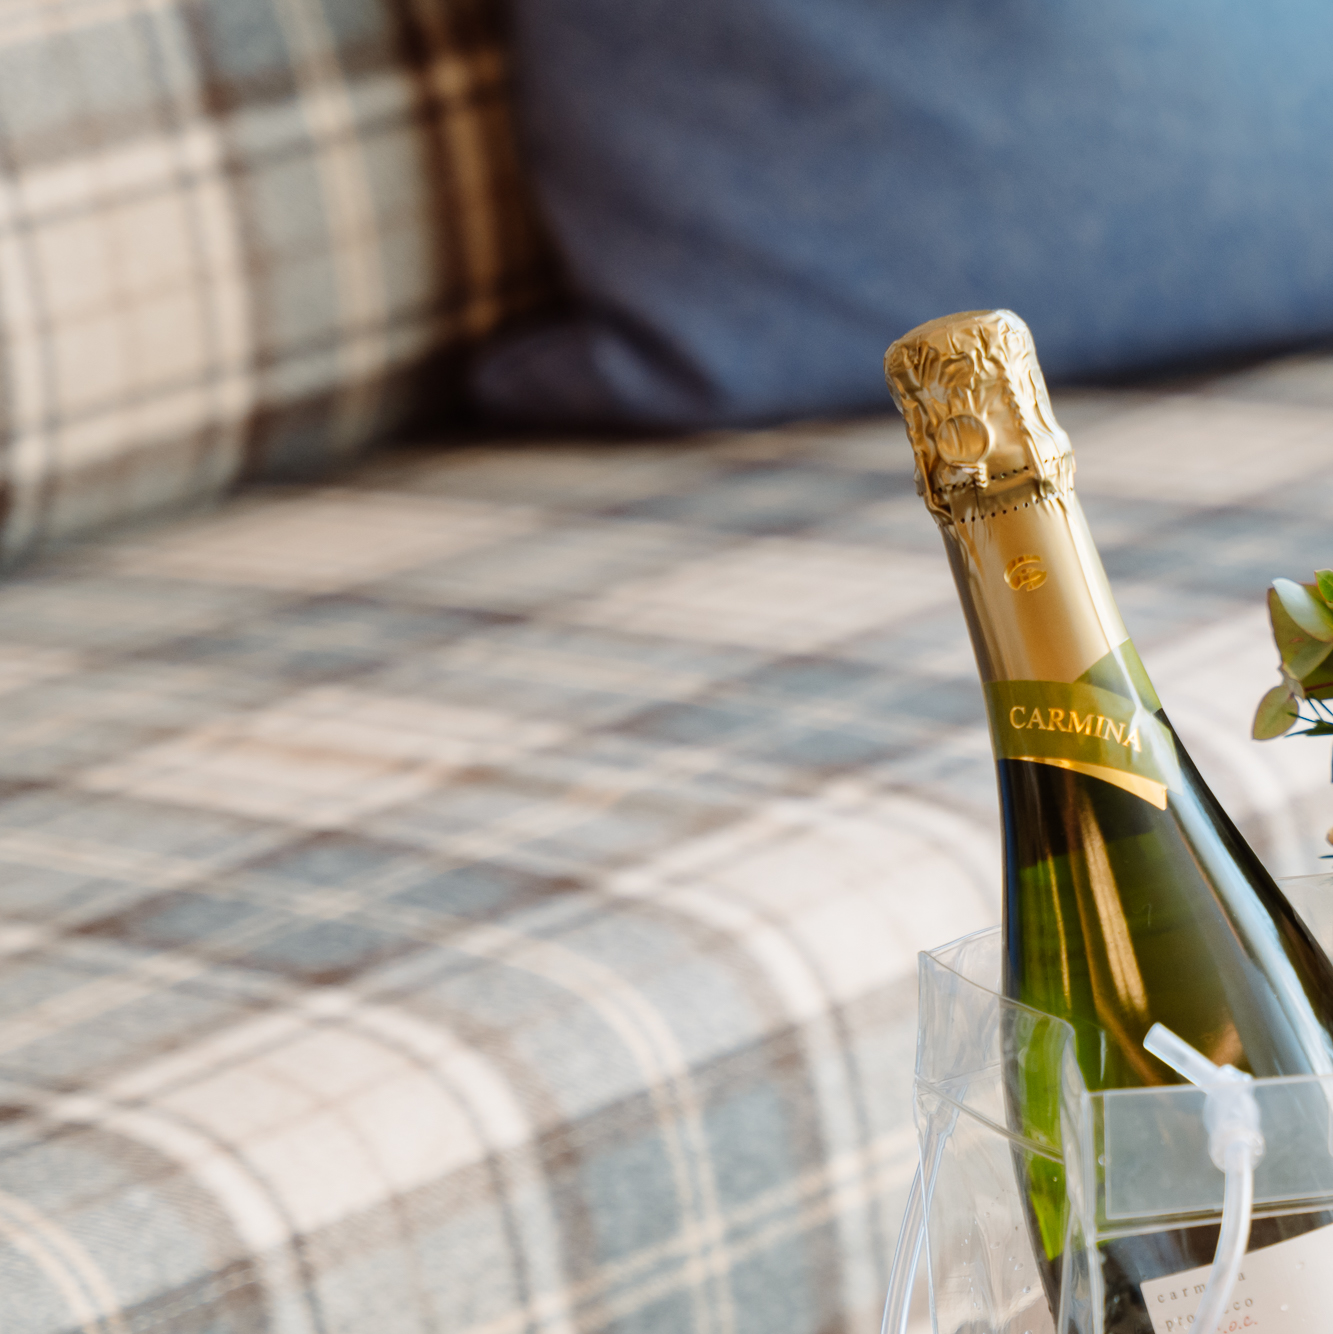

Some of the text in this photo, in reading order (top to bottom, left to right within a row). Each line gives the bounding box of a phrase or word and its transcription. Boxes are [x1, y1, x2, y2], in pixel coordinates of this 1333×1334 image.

[1009, 705, 1143, 752] CARMINA
[1157, 1272, 1246, 1304] carma
[1165, 1298, 1253, 1332] proco
